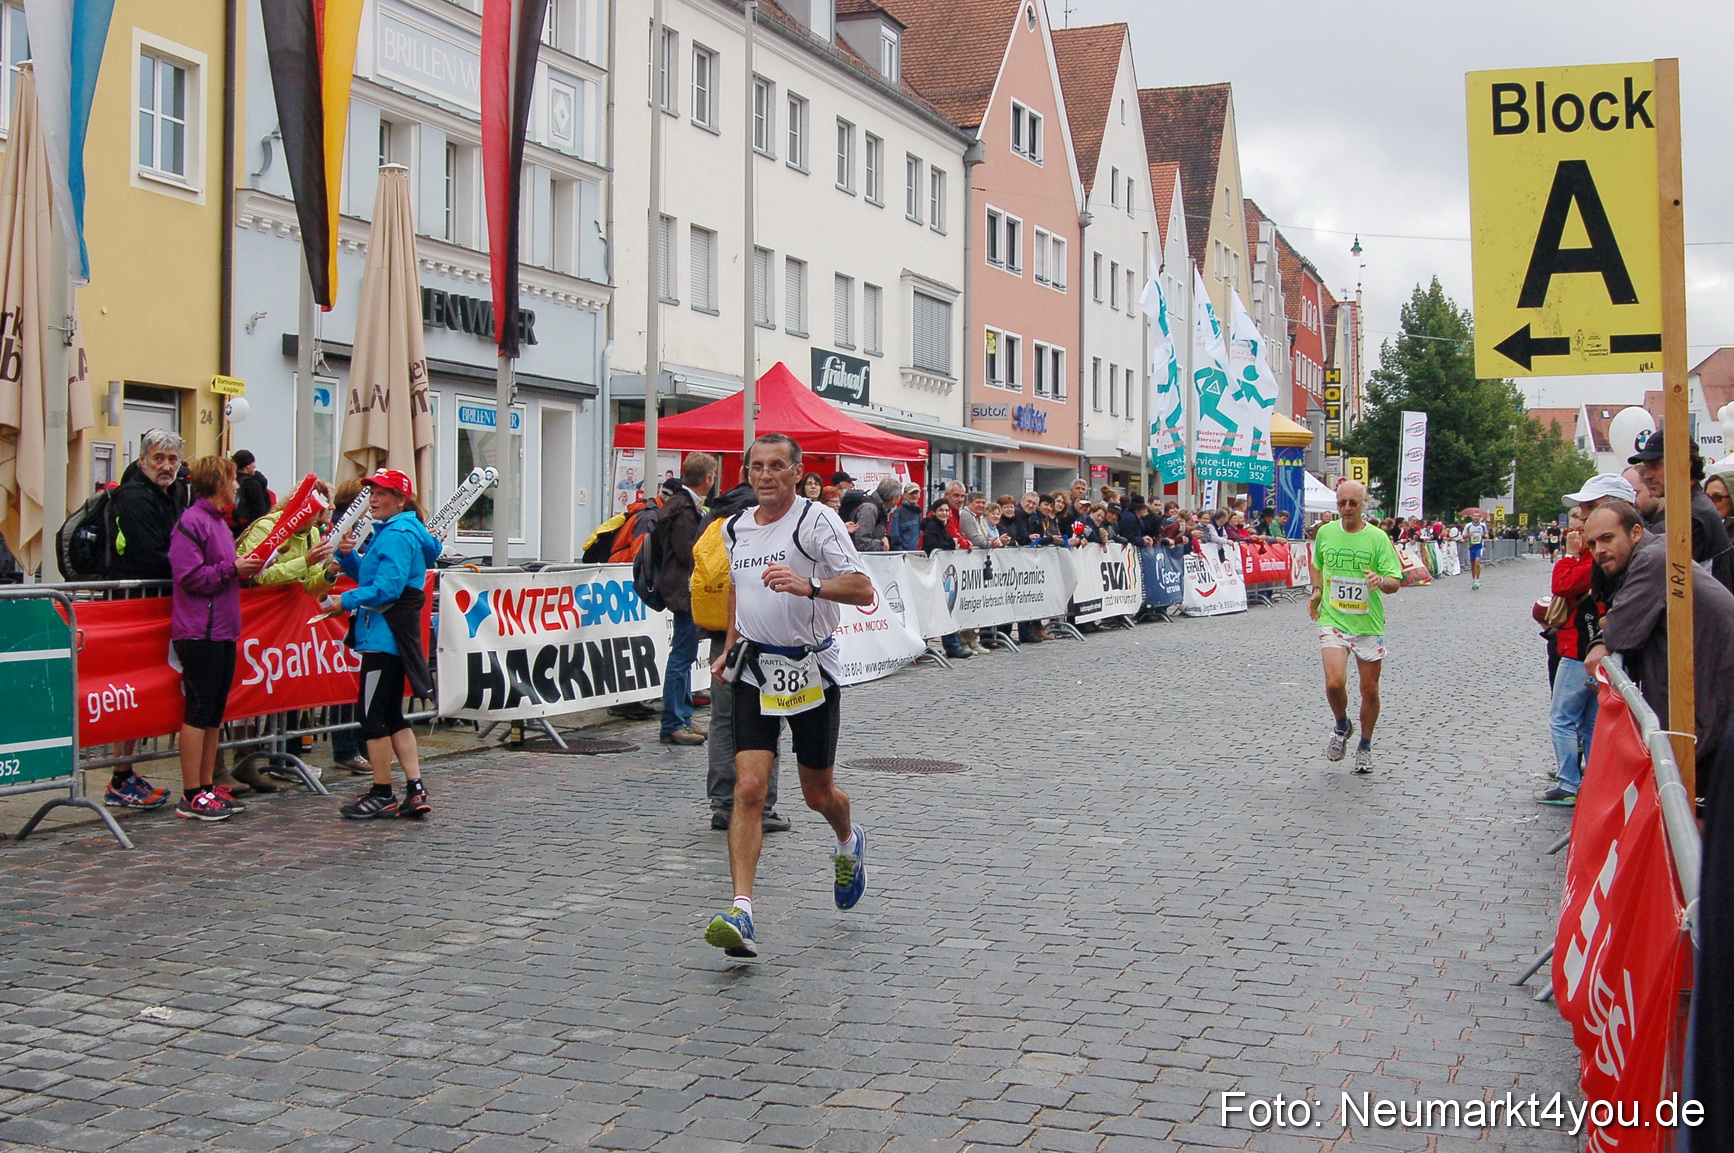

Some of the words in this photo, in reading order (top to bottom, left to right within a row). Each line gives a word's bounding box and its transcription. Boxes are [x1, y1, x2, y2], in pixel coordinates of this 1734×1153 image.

[384, 26, 456, 86] BRILLEN
[1491, 76, 1655, 136] Block
[1516, 158, 1641, 309] A
[816, 355, 870, 400] frühauf
[200, 409, 213, 425] 24
[462, 407, 491, 424] BRILLEN
[1325, 369, 1340, 455] HOTEL
[1215, 468, 1240, 479] 6352
[1249, 471, 1265, 480] 352
[1353, 466, 1363, 480] B
[286, 503, 313, 530] Audi
[1496, 509, 1503, 517] C
[264, 527, 289, 550] BKK
[733, 550, 786, 570] SIEMENS
[1326, 548, 1372, 570] OFF
[961, 569, 981, 591] BMW
[1338, 586, 1362, 601] 512
[461, 635, 662, 711] HACKNER
[760, 659, 784, 667] PARTL
[87, 683, 139, 724] geht
[777, 694, 807, 708] Werner
